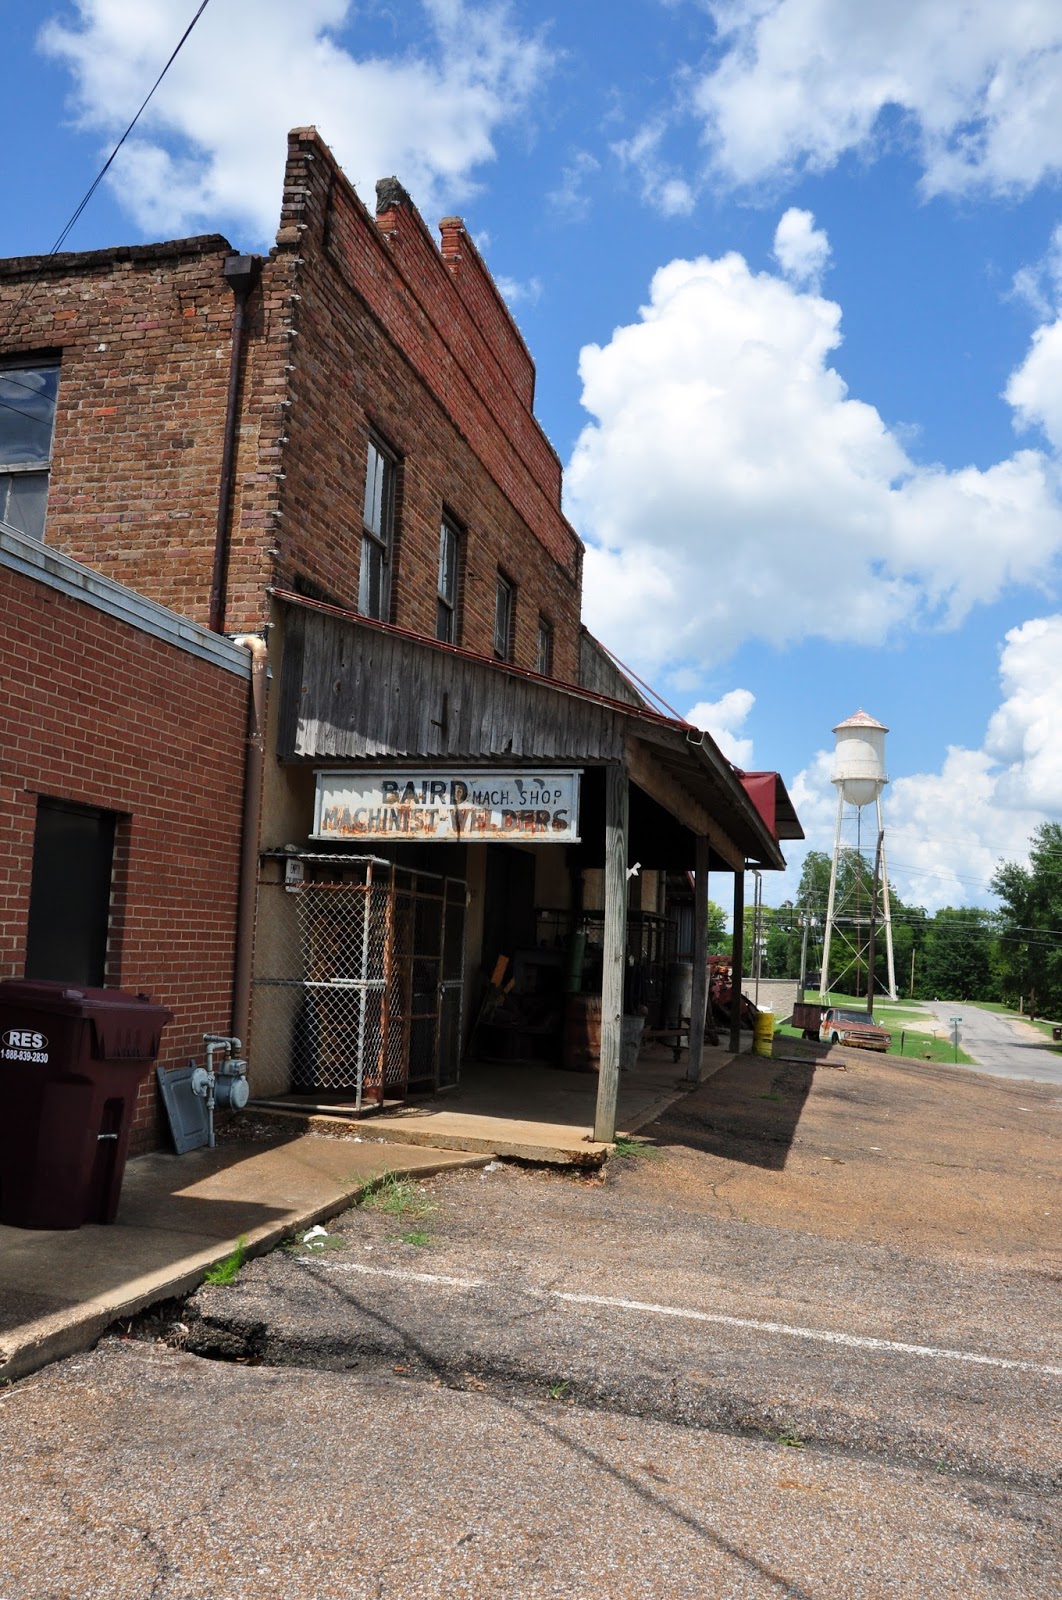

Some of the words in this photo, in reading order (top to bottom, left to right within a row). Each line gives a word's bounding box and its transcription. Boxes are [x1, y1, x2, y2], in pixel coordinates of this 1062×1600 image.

[382, 780, 468, 805] BAIRD
[472, 790, 513, 805] MACH.
[519, 790, 562, 805] SHOP
[9, 1031, 43, 1049] RES
